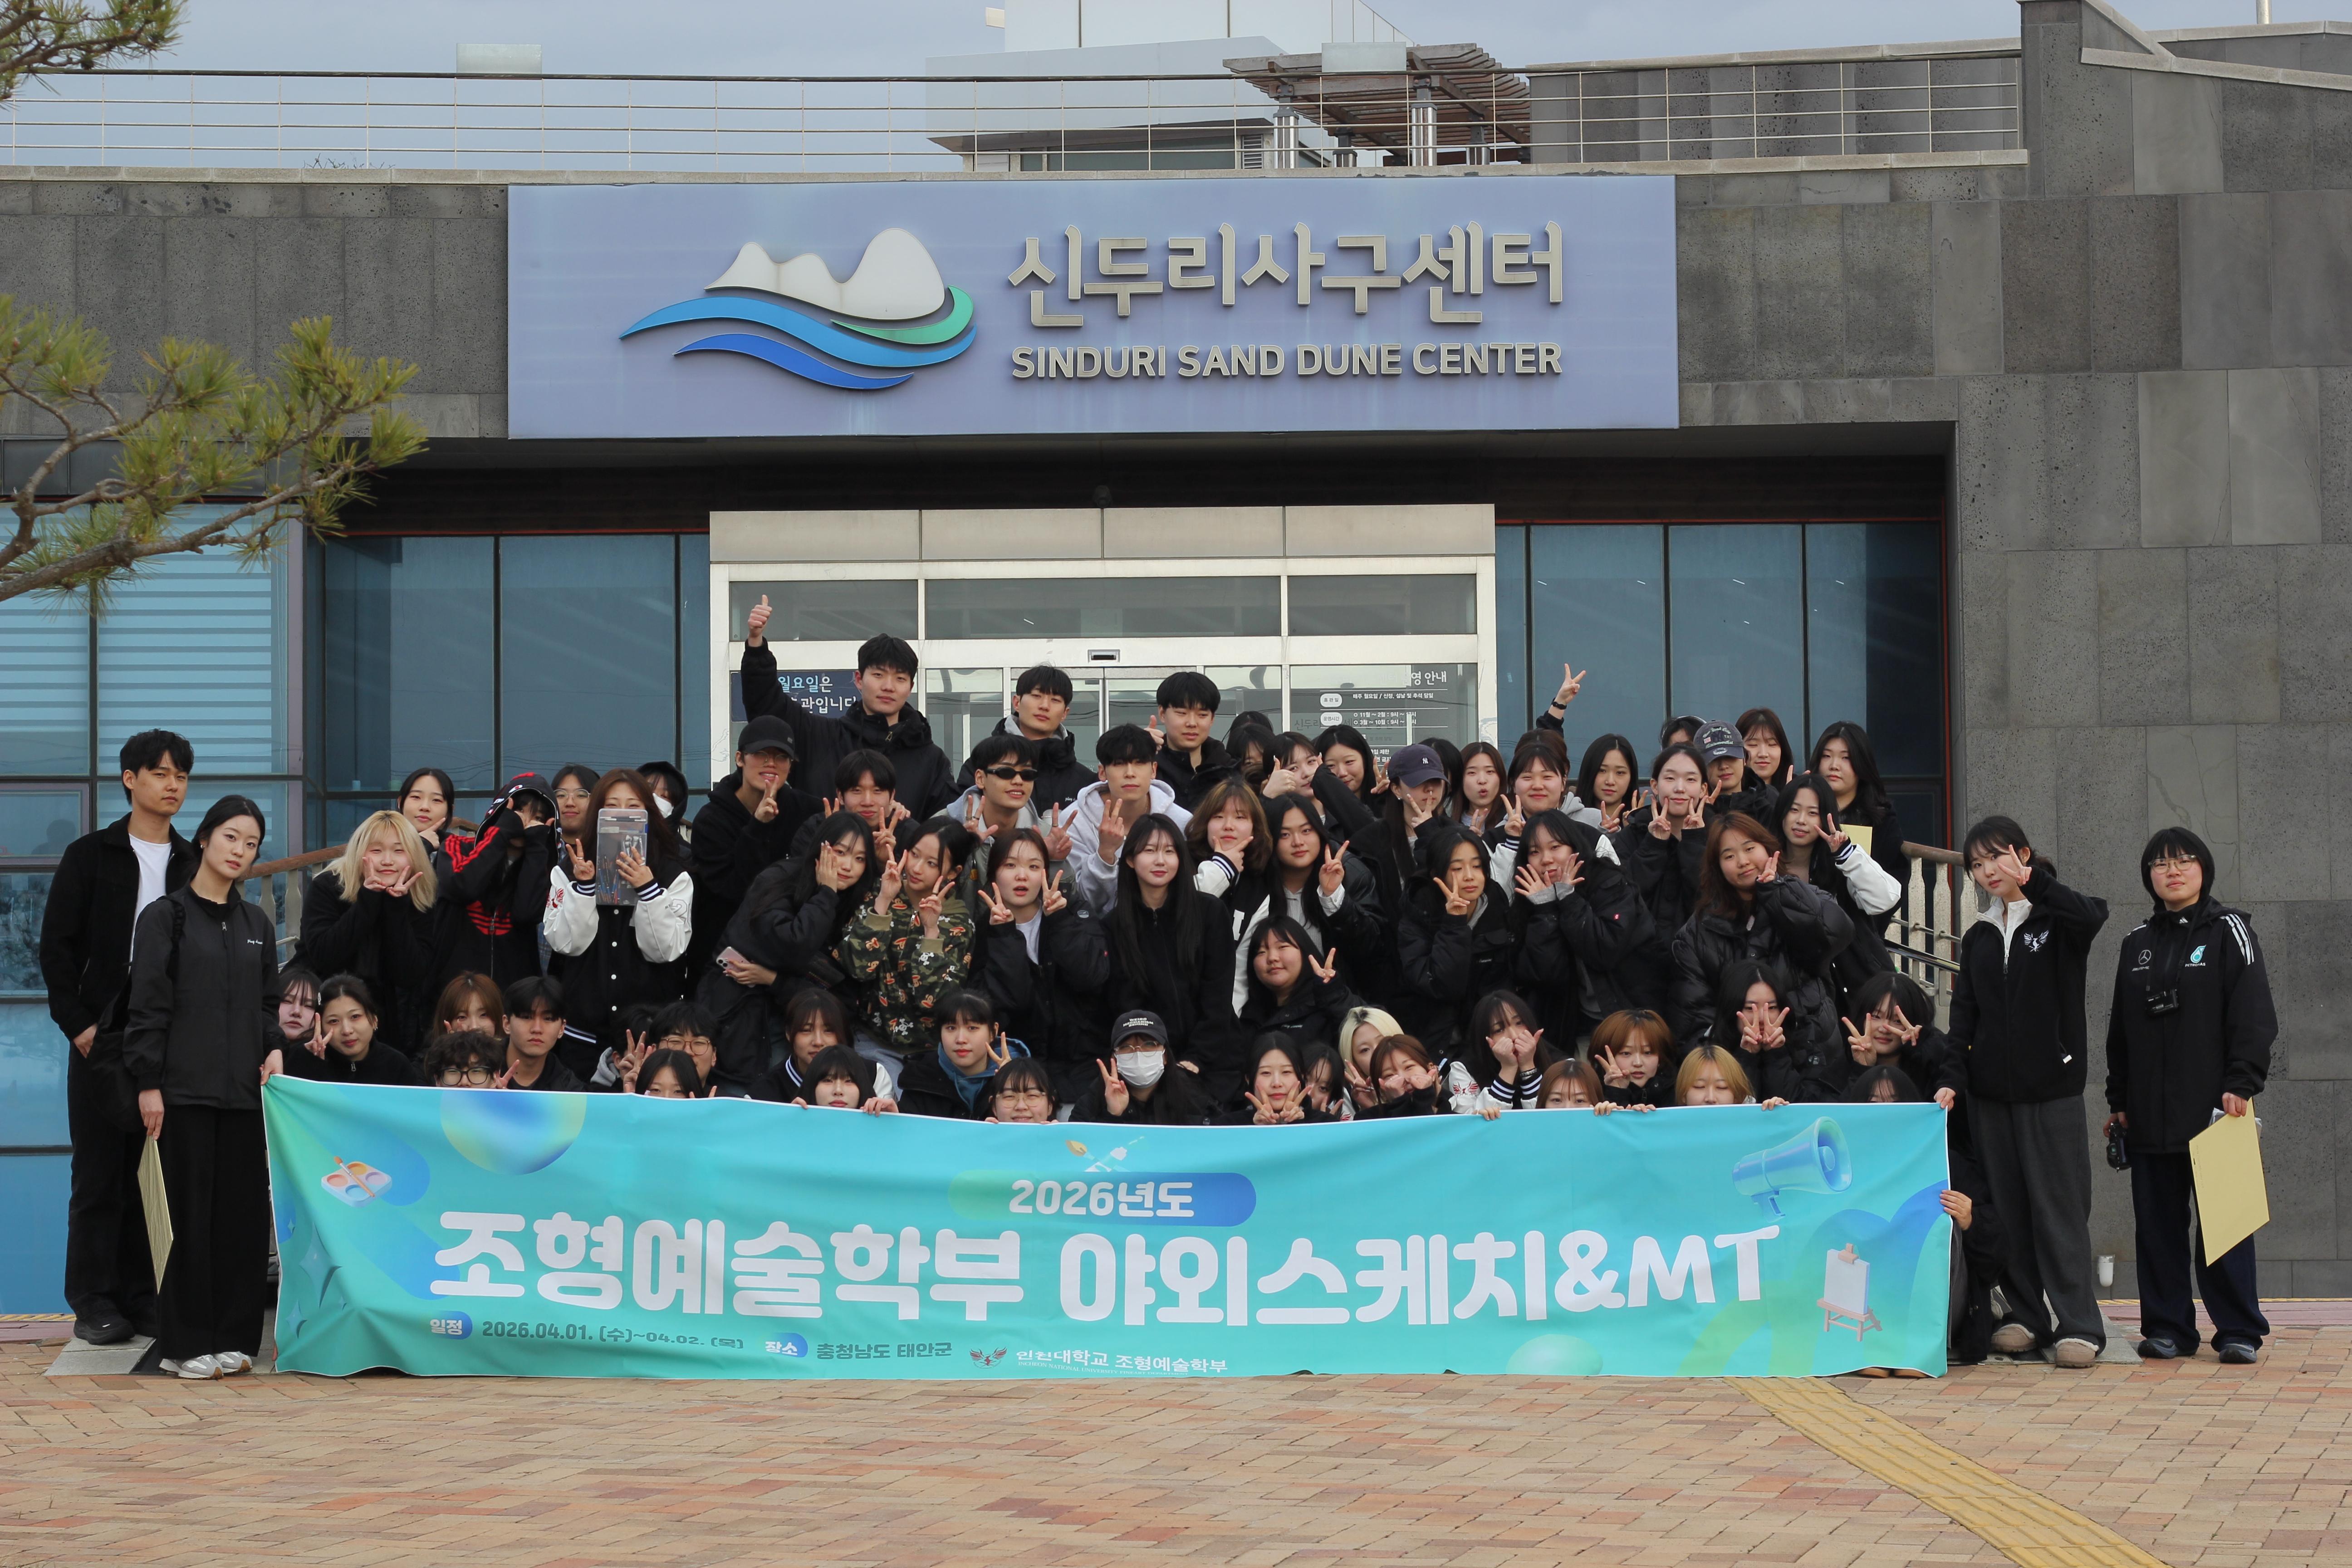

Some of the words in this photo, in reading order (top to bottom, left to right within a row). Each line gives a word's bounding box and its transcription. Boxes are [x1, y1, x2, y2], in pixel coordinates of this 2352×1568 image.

[1008, 220, 1563, 326] 신두리사구센터
[1012, 345, 1166, 378] SINDURI
[1178, 344, 1285, 377] SAND
[1297, 342, 1403, 375] DUNE
[1413, 341, 1563, 375] CENTER
[778, 675, 833, 693] 월요일은
[1425, 671, 1446, 685] 안내
[791, 696, 857, 714] 관입니다
[1009, 1179, 1195, 1217] 2026년도
[429, 1210, 1024, 1321] 조형예술학부
[1059, 1225, 1780, 1326] 야외스케치&MT
[430, 1318, 463, 1336] 일정
[765, 1341, 798, 1356] 장소
[817, 1343, 891, 1360] 충청남도
[897, 1342, 952, 1358] 태안군
[1016, 1349, 1109, 1367] 인천대학교
[1115, 1354, 1228, 1373] 조형예술학부
[1049, 1363, 1080, 1372] NATIONAL
